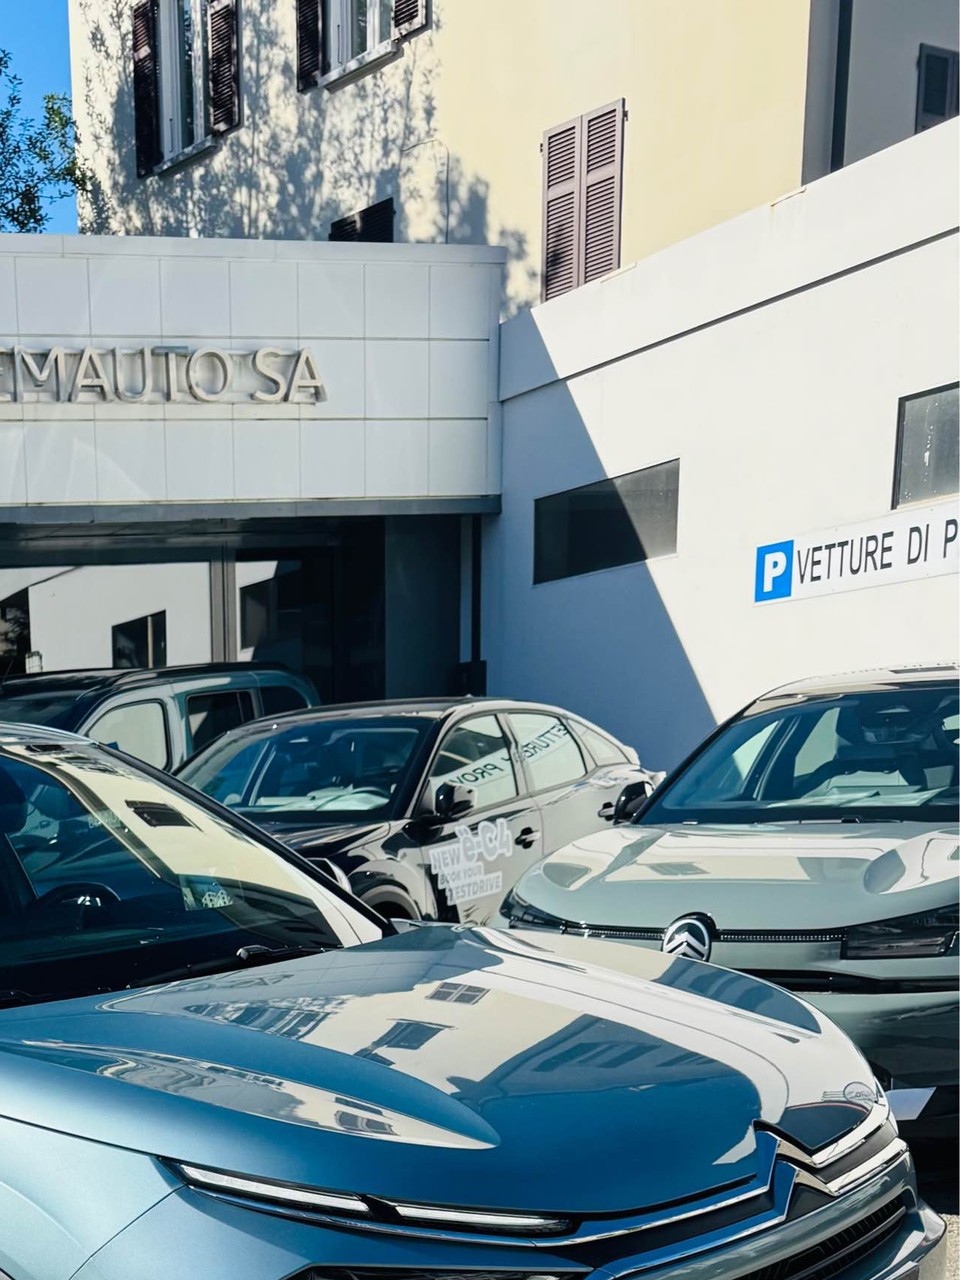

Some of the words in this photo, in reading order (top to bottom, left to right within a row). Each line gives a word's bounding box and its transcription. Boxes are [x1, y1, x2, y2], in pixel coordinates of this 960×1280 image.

[250, 346, 328, 404] SA
[762, 551, 788, 593] P
[797, 531, 894, 584] VETTURE
[907, 524, 930, 565] DI
[431, 847, 461, 873] NEW
[448, 875, 501, 902] TESTDRIVE
